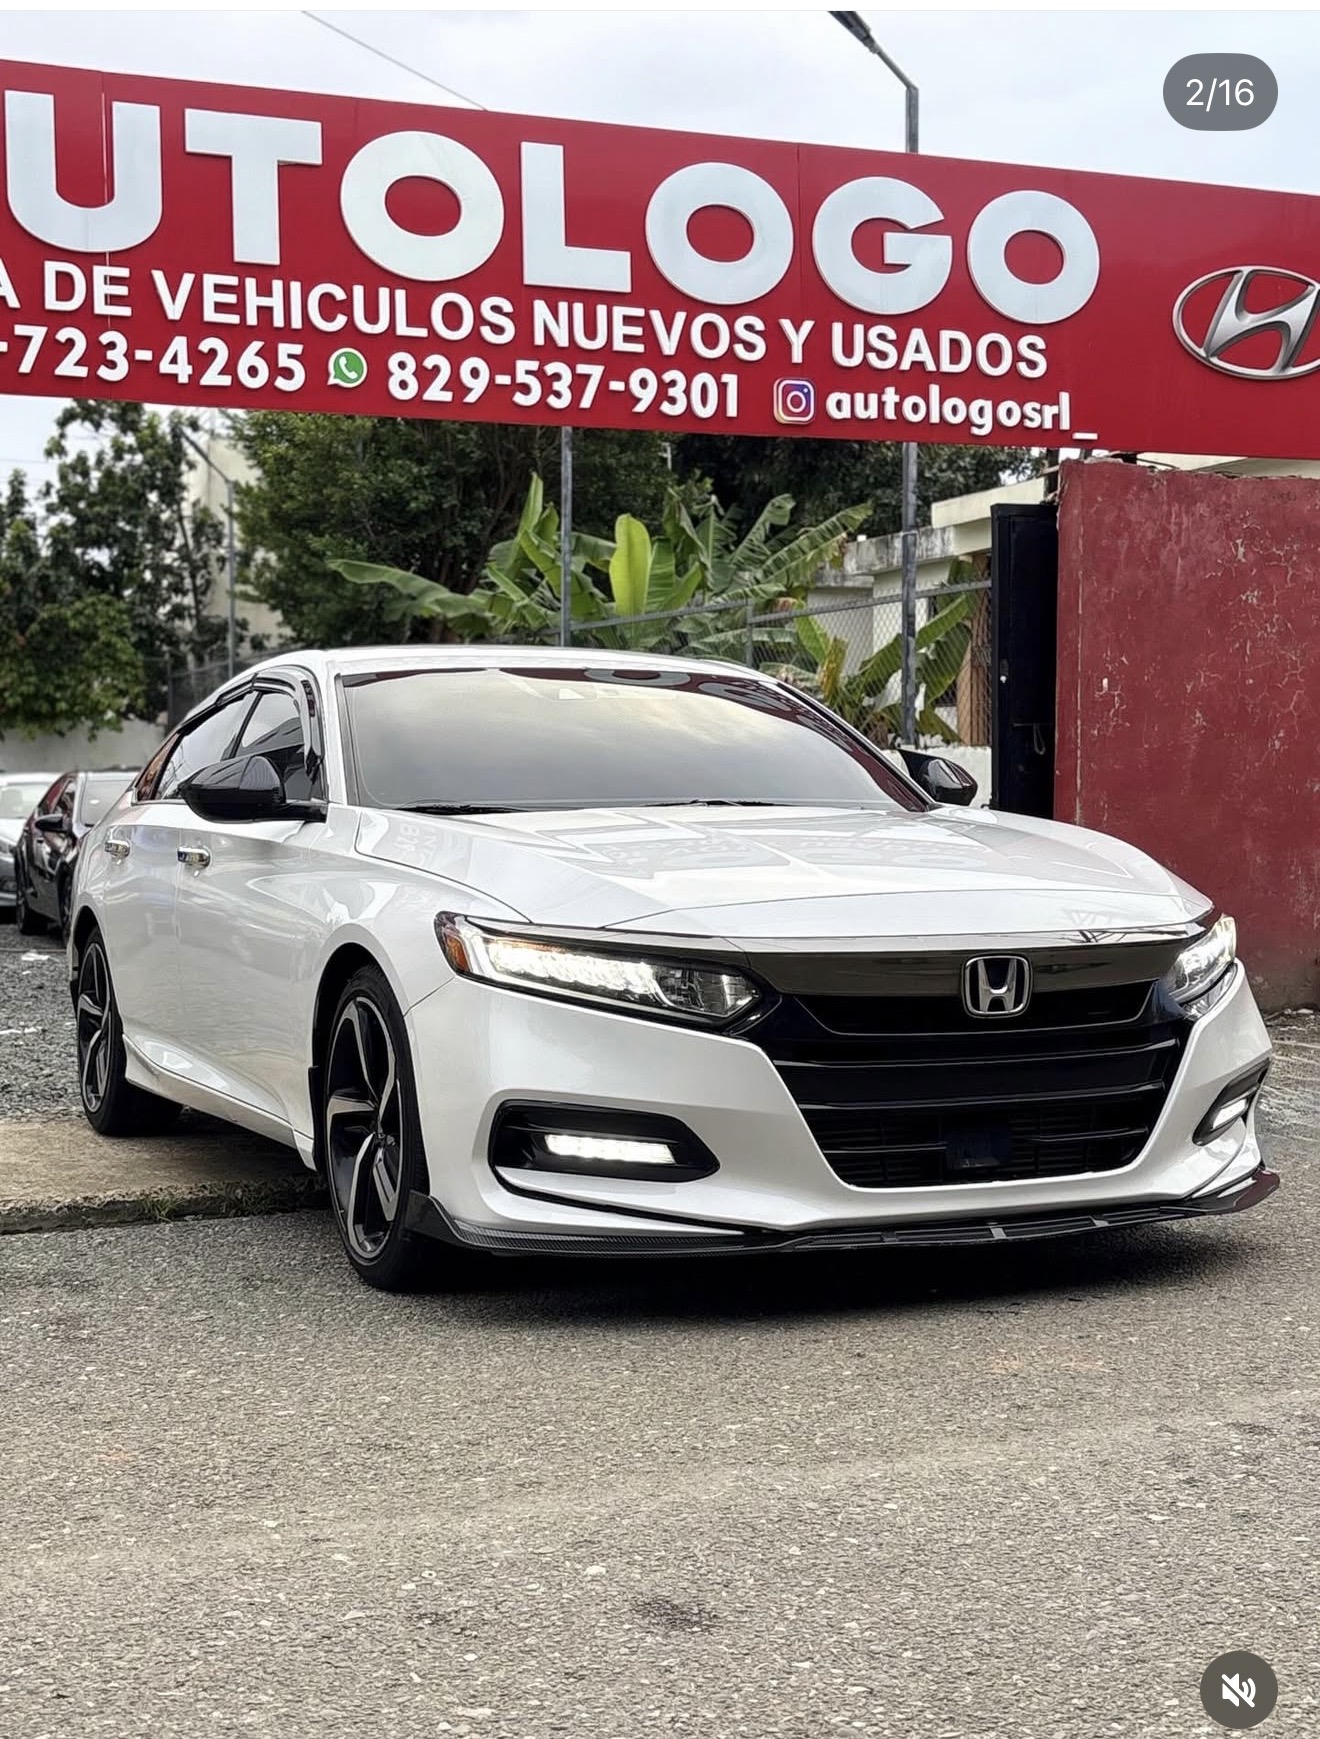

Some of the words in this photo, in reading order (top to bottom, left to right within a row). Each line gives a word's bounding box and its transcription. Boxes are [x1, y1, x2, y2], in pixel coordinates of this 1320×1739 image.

[44, 260, 132, 317] DE
[151, 269, 516, 345] VEHICULOS
[533, 299, 767, 362] NUEVOS
[778, 318, 815, 364] Y
[831, 321, 1048, 378] USADOS
[387, 350, 740, 419] 829-537-9301
